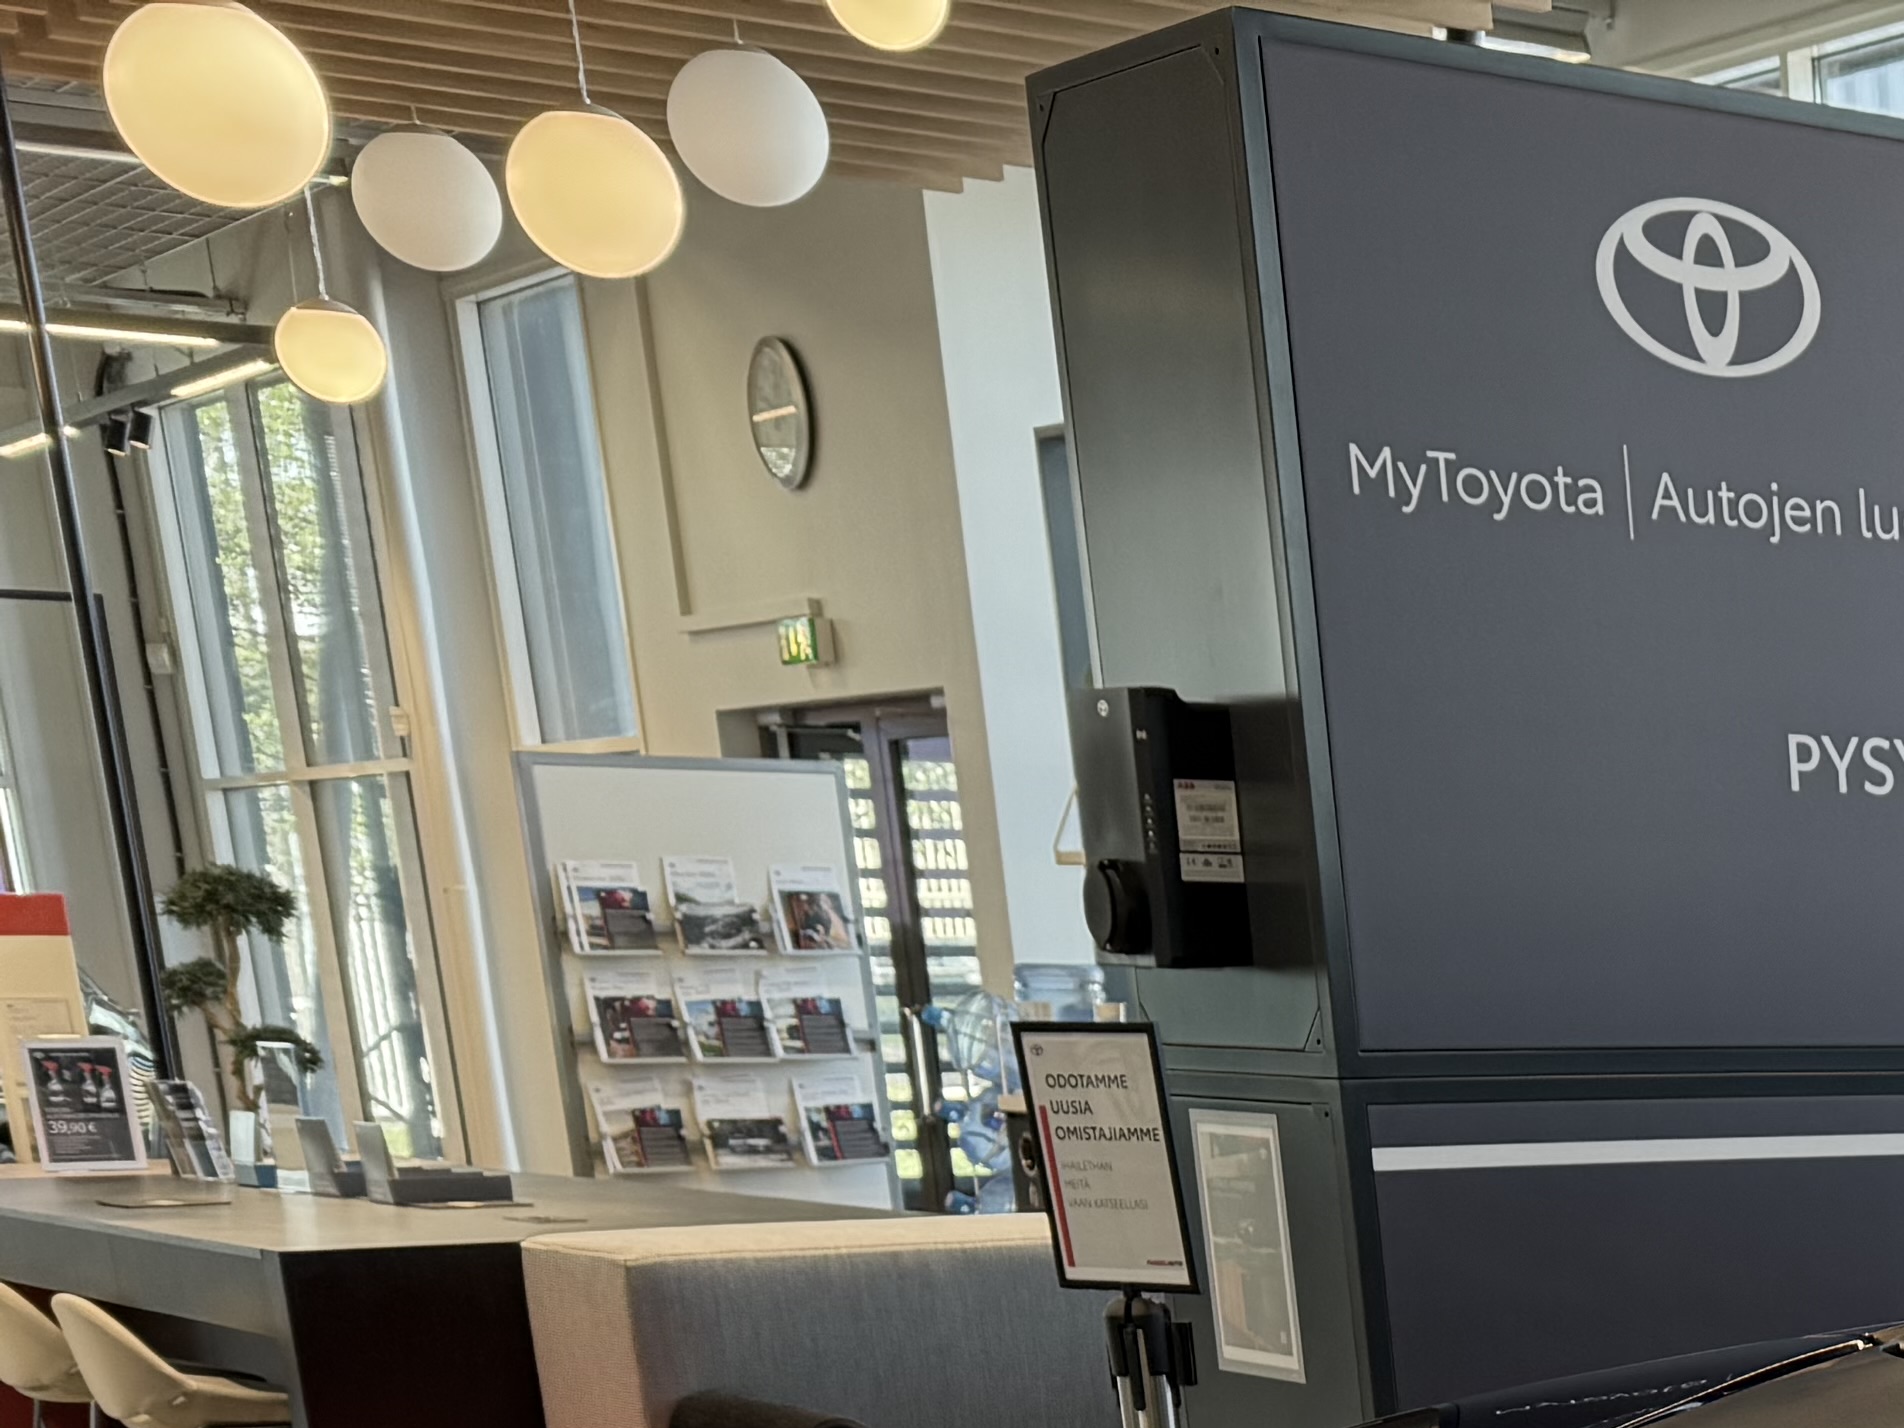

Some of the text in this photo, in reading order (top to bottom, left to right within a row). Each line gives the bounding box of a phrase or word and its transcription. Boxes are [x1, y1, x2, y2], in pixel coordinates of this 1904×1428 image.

[1348, 442, 1605, 521] MyToyota
[1651, 471, 1843, 544] Autojen
[1045, 1073, 1129, 1090] ODOTAMME
[1049, 1099, 1094, 1116] UUSIA
[1054, 1125, 1161, 1143] OMISTAJIAMME
